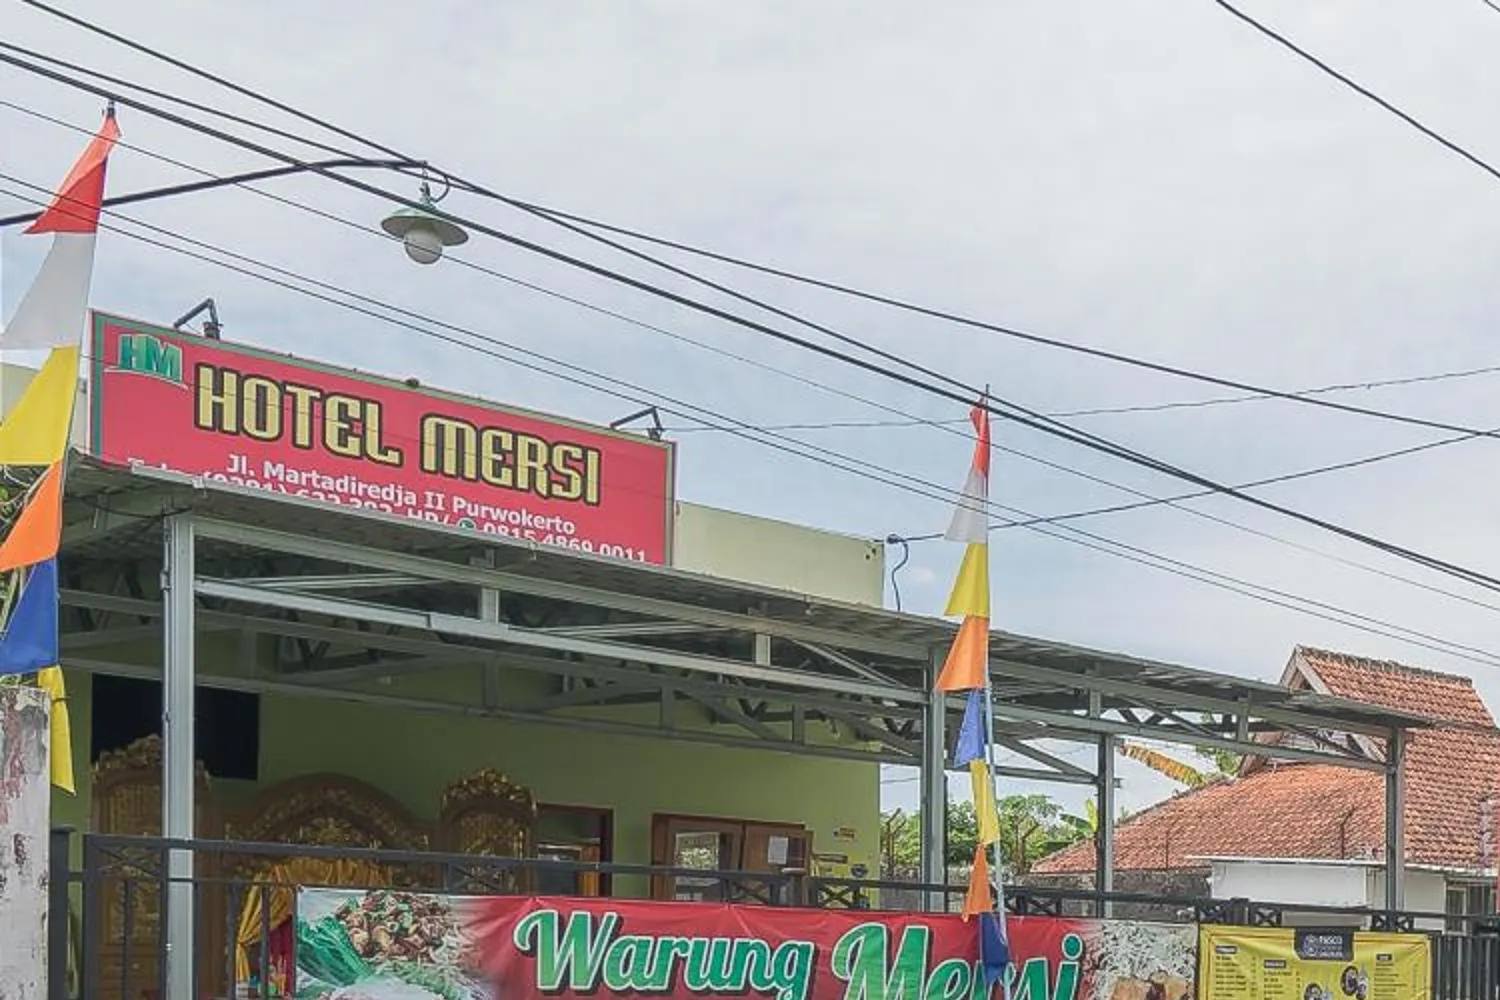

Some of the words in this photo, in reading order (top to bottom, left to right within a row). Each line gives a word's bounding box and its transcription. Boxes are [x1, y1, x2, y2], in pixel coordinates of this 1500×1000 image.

[117, 333, 184, 384] HM
[194, 361, 405, 467] HOTEL
[419, 412, 602, 507] MERSI
[226, 453, 255, 477] Jl.
[263, 460, 417, 508] Martadiredja
[424, 490, 446, 511] II
[452, 496, 576, 535] Purwokerto
